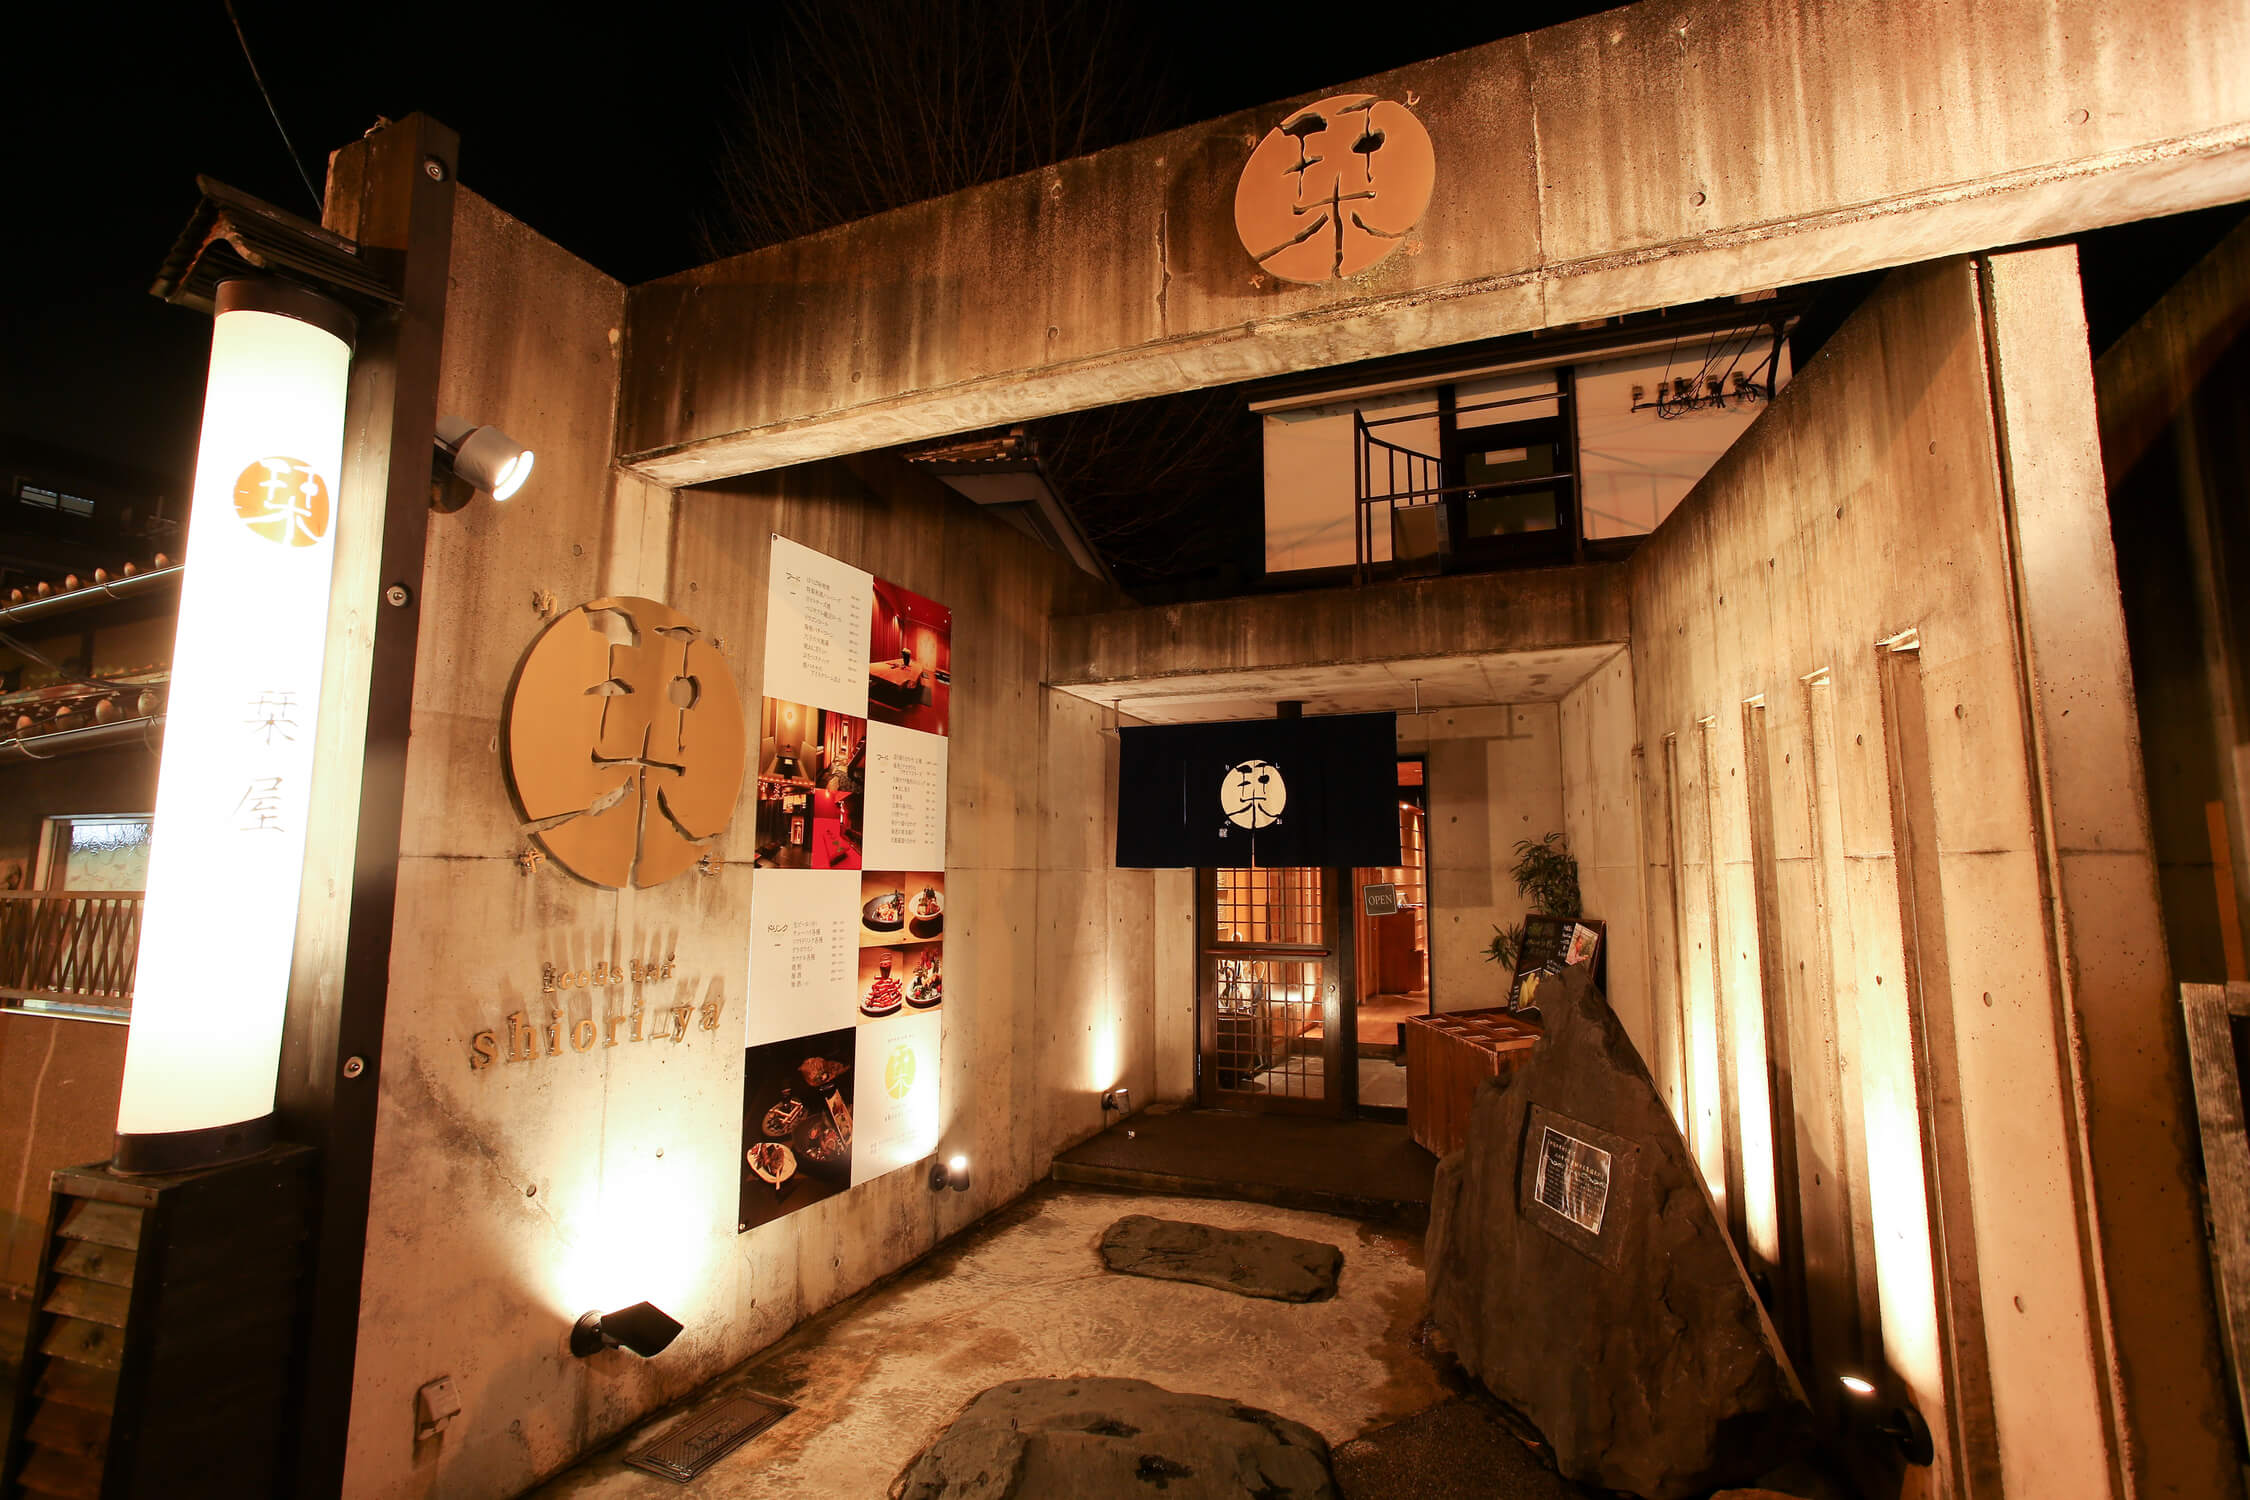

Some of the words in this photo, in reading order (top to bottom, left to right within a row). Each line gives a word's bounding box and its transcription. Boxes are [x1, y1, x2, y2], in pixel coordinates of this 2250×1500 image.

[231, 688, 299, 834] 栞屋
[1368, 894, 1393, 906] OPEN
[543, 961, 625, 994] foods
[630, 951, 677, 984] bar
